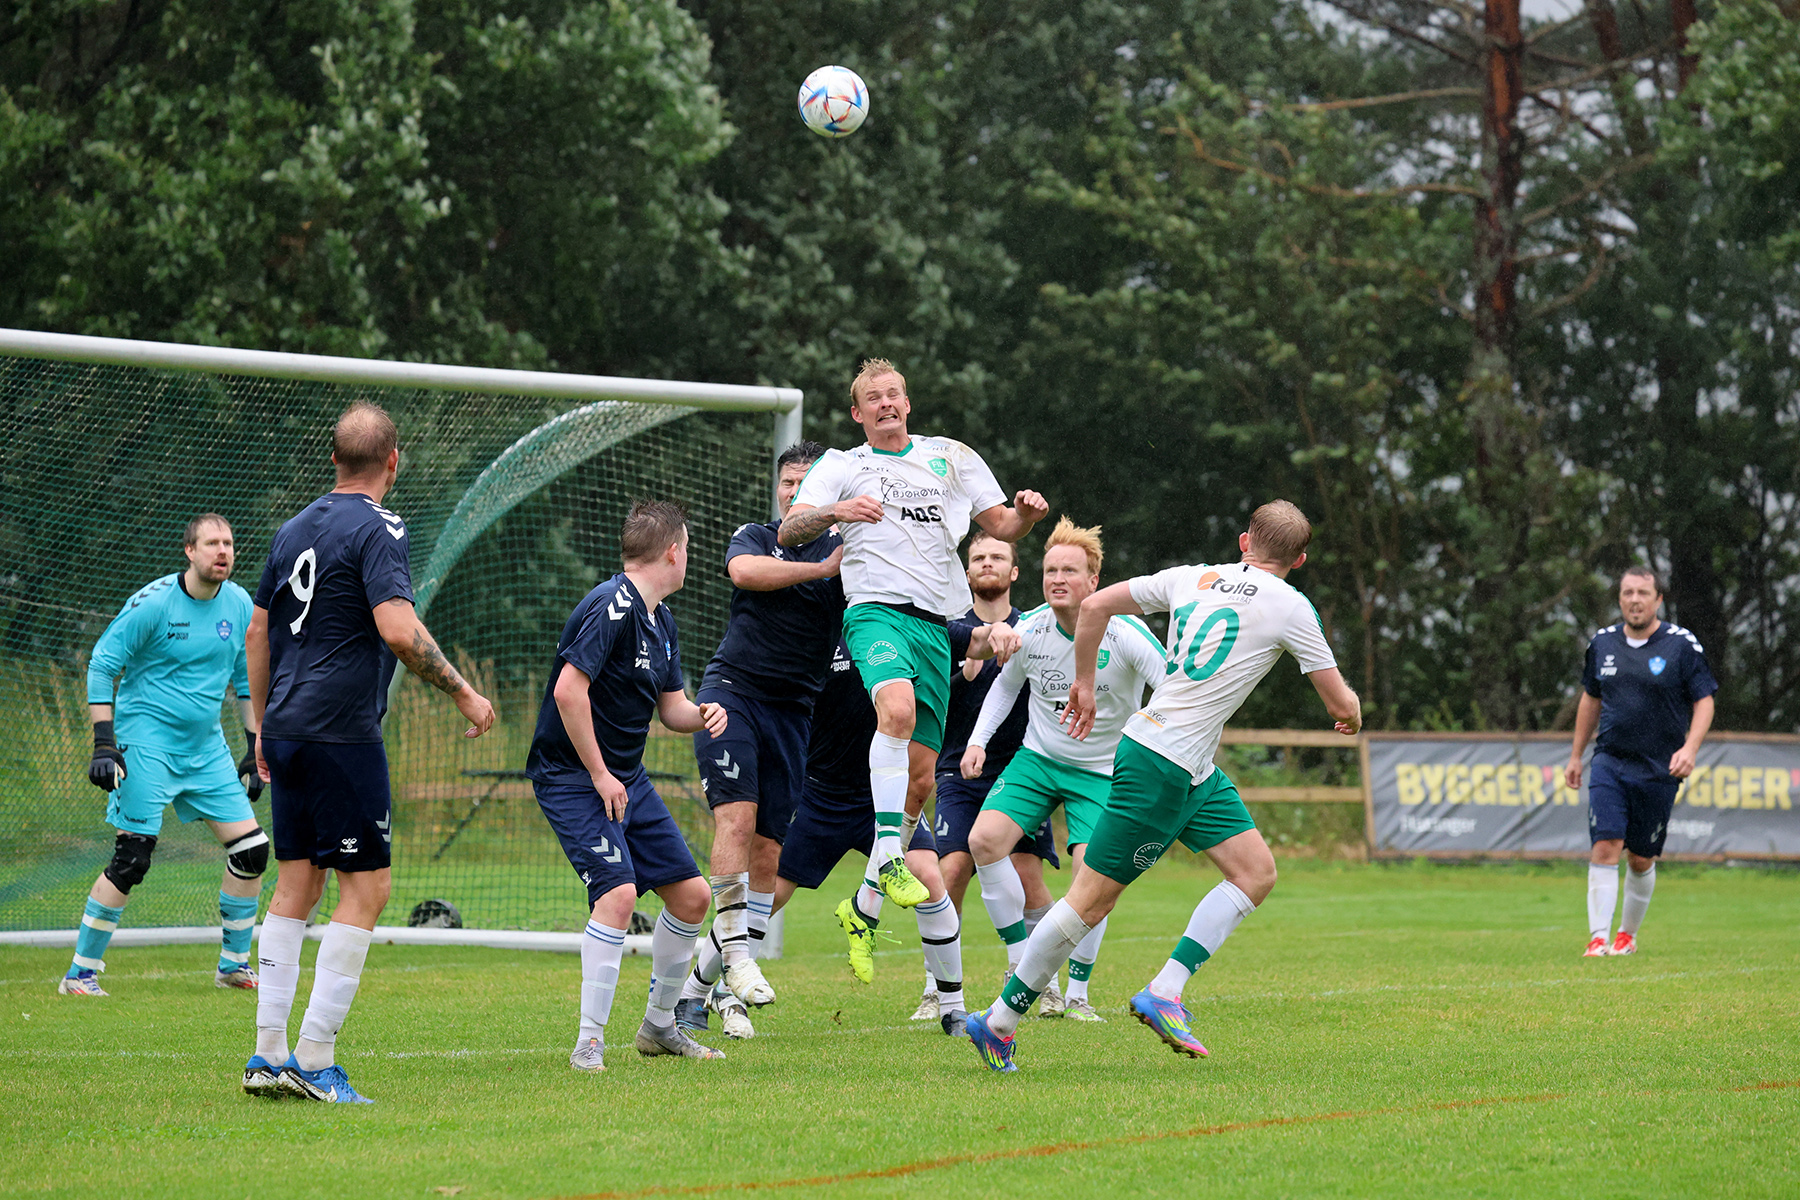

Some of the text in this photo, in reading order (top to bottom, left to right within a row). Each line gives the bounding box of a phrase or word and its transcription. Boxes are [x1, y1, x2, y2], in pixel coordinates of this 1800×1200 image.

[931, 460, 945, 468] FIL
[892, 488, 940, 499] BJØRØYA
[900, 505, 942, 523] AQS
[288, 547, 316, 635] 9
[1035, 626, 1051, 635] NTE
[1166, 600, 1240, 681] 10
[1097, 684, 1109, 692] AS
[1395, 763, 1580, 806] BYGGER'N
